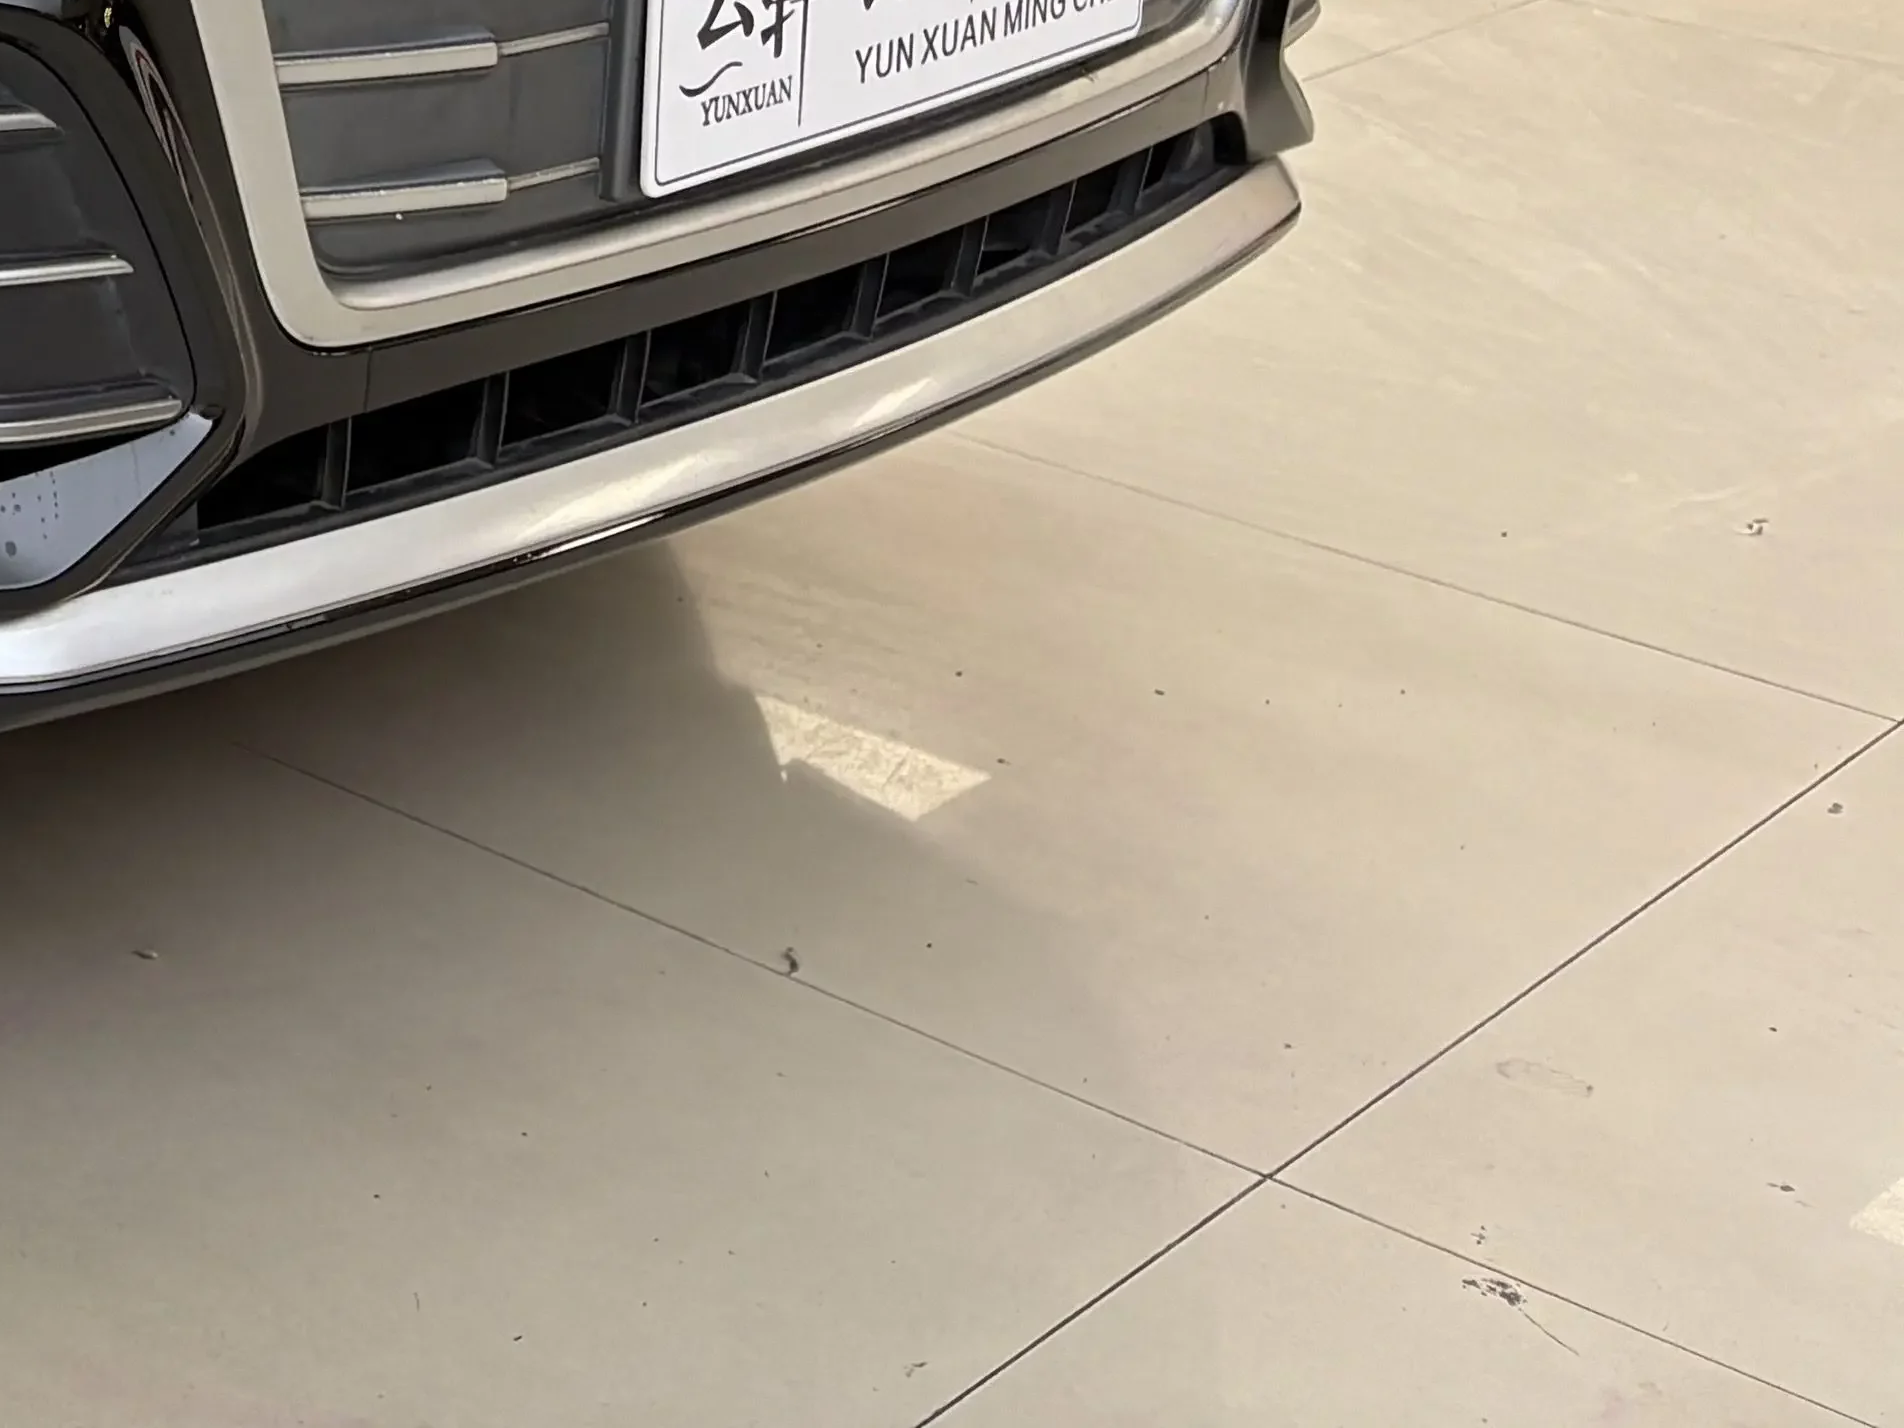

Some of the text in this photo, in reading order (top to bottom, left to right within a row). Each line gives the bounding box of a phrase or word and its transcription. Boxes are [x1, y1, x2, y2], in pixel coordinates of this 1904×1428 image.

[855, 32, 914, 84] YUN
[921, 7, 996, 65] XUAN
[700, 74, 793, 128] YUNXUAN
